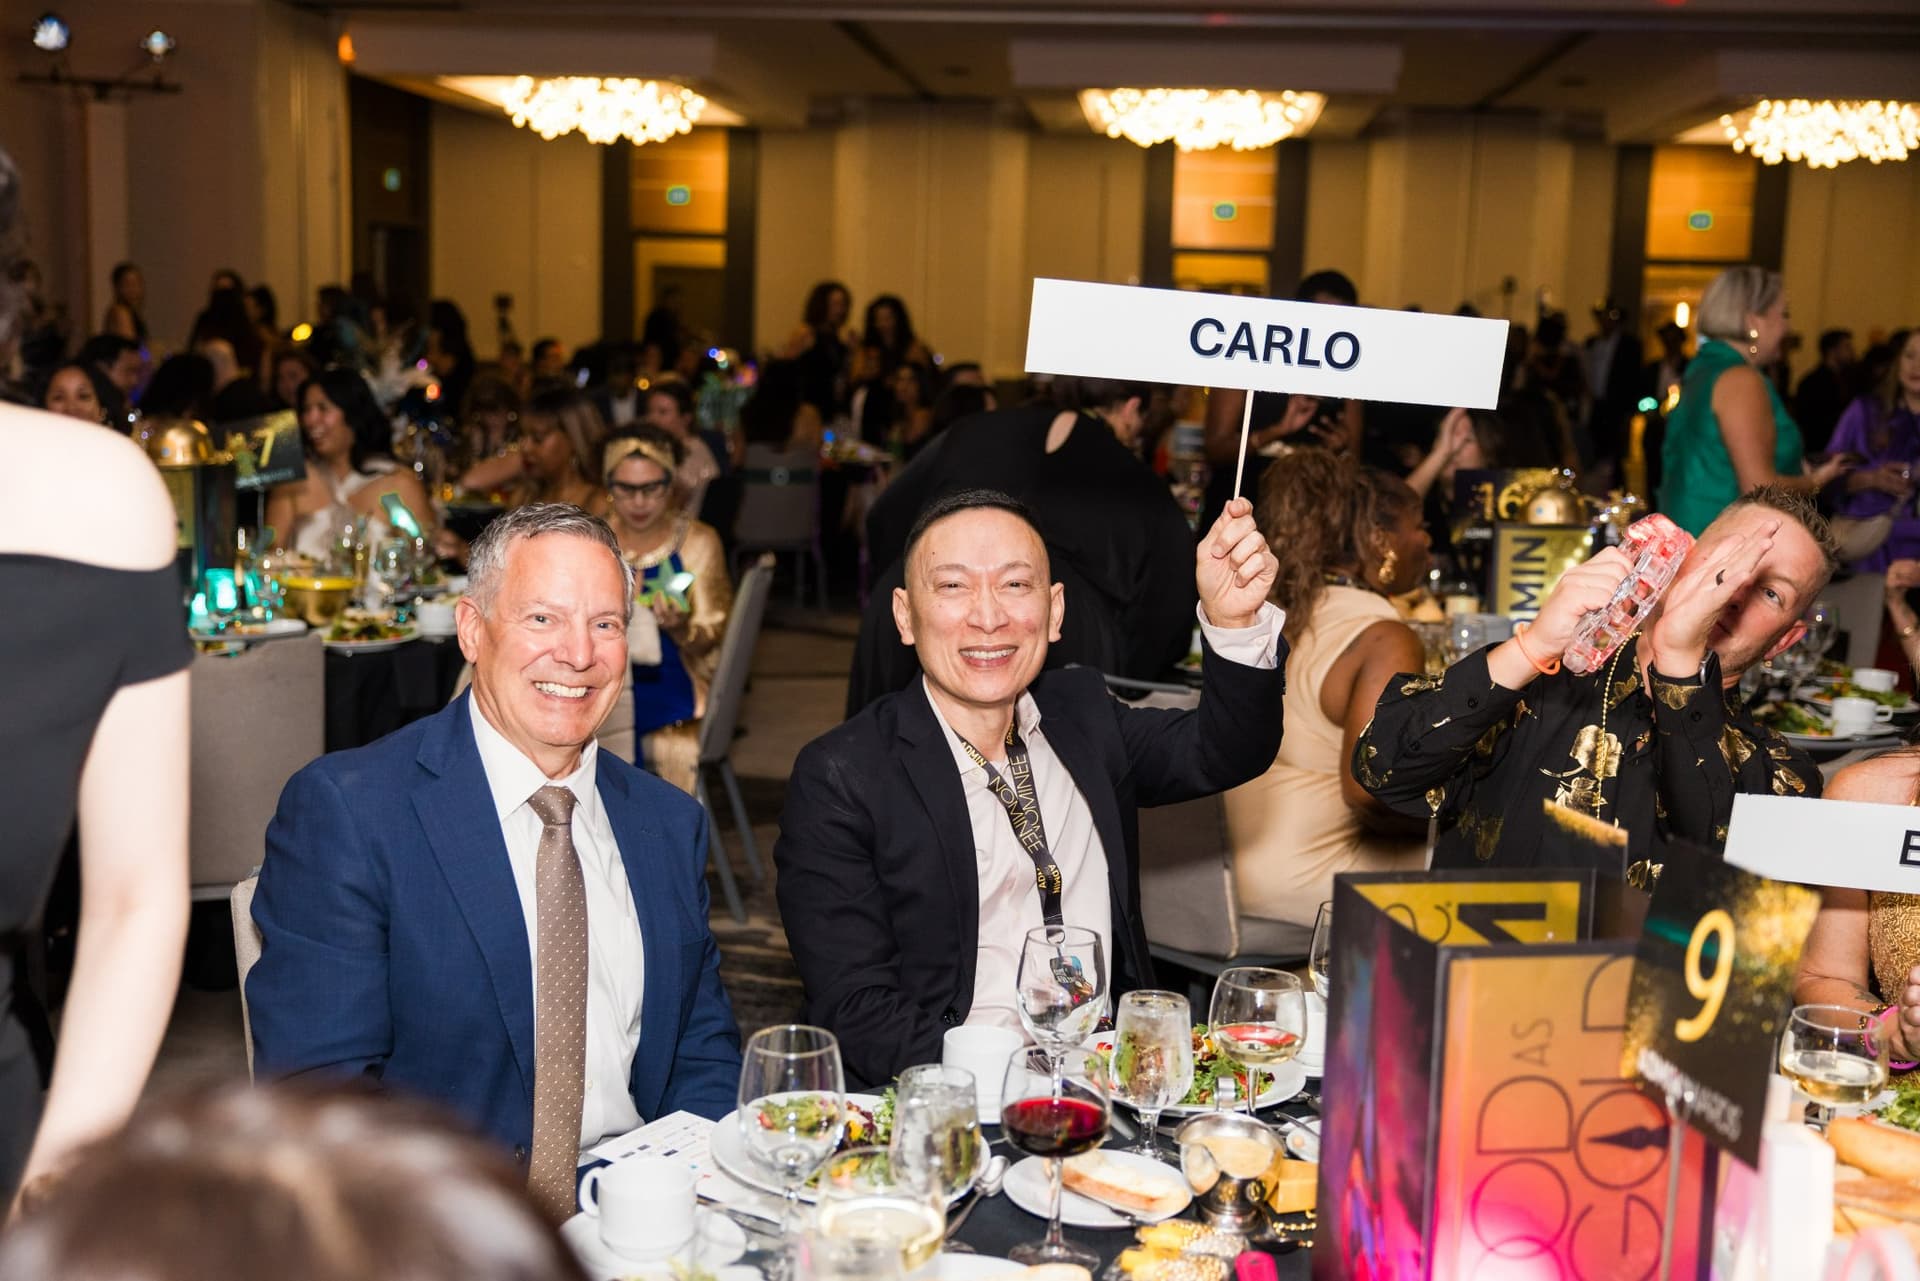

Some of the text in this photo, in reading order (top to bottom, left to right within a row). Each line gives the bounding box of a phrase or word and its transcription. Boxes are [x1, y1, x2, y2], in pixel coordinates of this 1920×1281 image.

[1190, 317, 1361, 370] CARLO
[254, 428, 276, 468] 7
[1479, 481, 1525, 521] 16
[988, 775, 1044, 854] NOMINEE
[1675, 909, 1735, 1043] 9
[1511, 1018, 1555, 1069] AS
